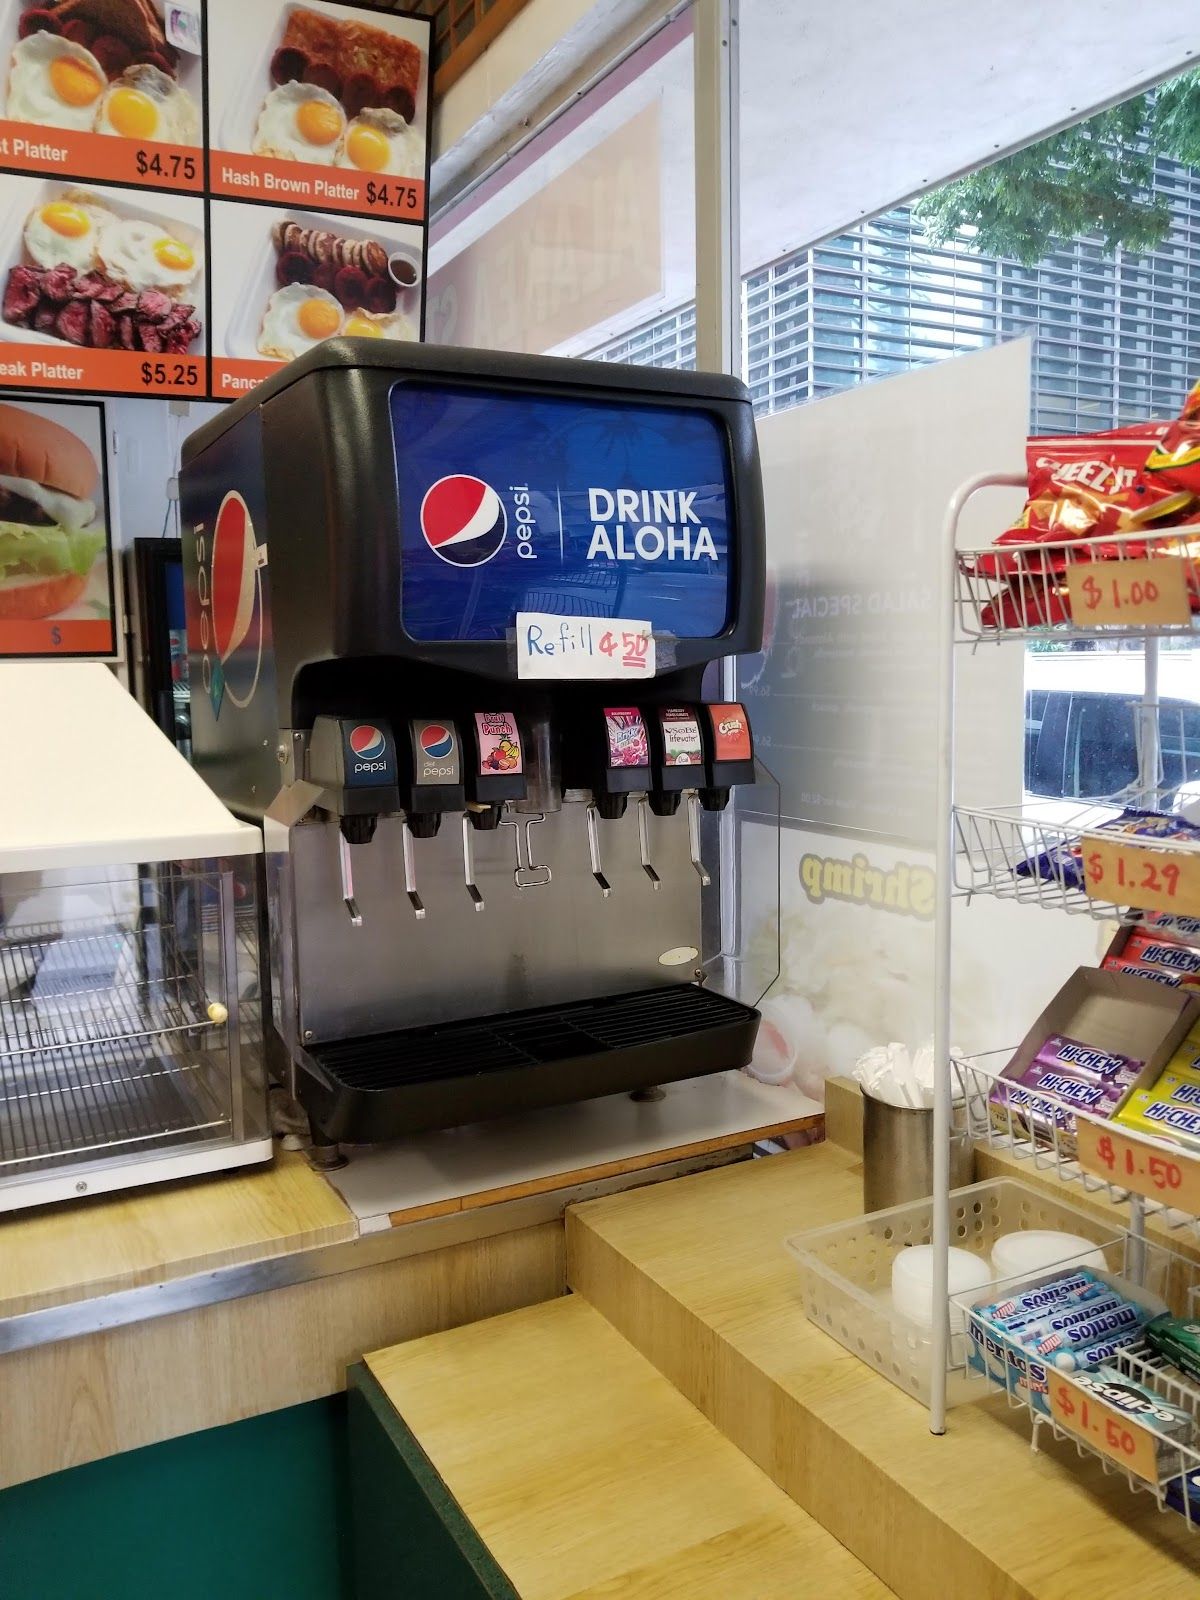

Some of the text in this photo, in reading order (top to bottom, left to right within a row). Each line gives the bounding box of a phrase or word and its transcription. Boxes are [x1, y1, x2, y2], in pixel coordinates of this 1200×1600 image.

[13, 138, 69, 162] Platter
[136, 150, 196, 180] $4.75
[221, 166, 360, 200] Hash Brown Platter
[366, 181, 417, 208] $4.75
[31, 362, 84, 380] Platter
[141, 361, 198, 386] $5.25
[588, 487, 701, 524] DRINK
[509, 484, 537, 559] pepsi
[586, 525, 719, 561] ALOHA
[51, 626, 62, 645] $
[527, 622, 593, 656] Refill
[482, 724, 513, 735] Punch
[669, 734, 697, 743] lifewater
[718, 720, 742, 735] Crush
[354, 760, 387, 773] pepsi
[423, 765, 454, 777] pepsi
[1056, 1044, 1122, 1075] HI-CHEW
[1037, 1072, 1104, 1104] HI-CHEW
[1143, 1101, 1200, 1134] HI-CHE
[1066, 1306, 1138, 1343] mentos
[969, 1319, 1047, 1382] mentos
[1072, 1374, 1176, 1422] eclipse
